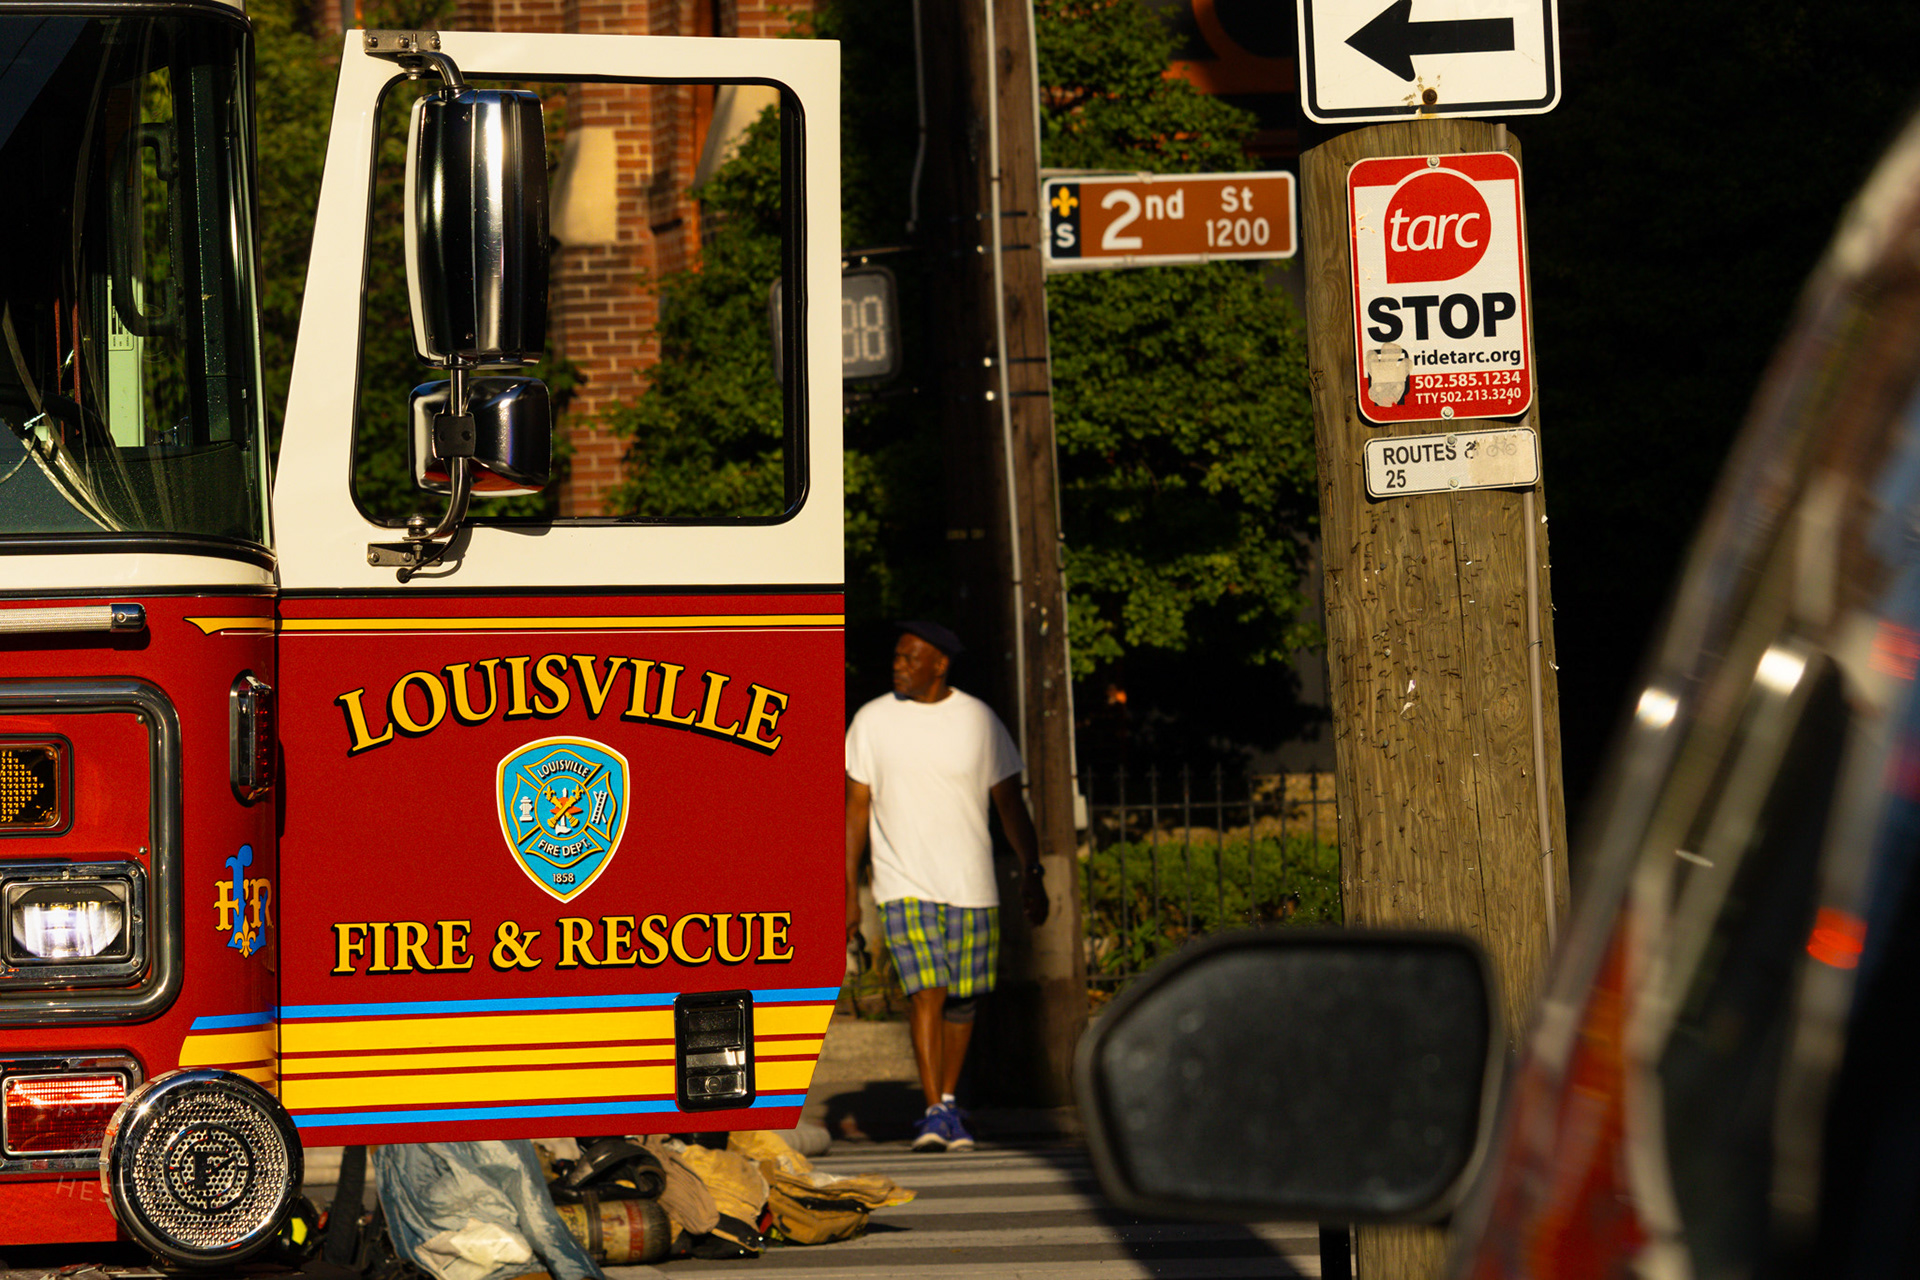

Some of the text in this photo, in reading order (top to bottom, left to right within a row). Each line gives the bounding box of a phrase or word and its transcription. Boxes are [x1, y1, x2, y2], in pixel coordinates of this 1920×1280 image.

[1101, 185, 1254, 250] 2nd St
[1056, 222, 1076, 248] S
[1206, 216, 1270, 248] 1200
[1389, 208, 1480, 253] tarc
[1367, 291, 1516, 343] STOP
[1413, 349, 1521, 366] ridetarc.org
[1415, 371, 1521, 389] 502.585.1234
[1383, 443, 1457, 466] ROUTES
[1385, 469, 1407, 489] 25
[335, 653, 790, 757] LOUISVILLE
[537, 759, 590, 778] LOUISVILLE
[537, 837, 591, 857] FIRE DEPT.
[552, 872, 575, 884] 1858
[331, 911, 795, 976] FIRE & RESCUE
